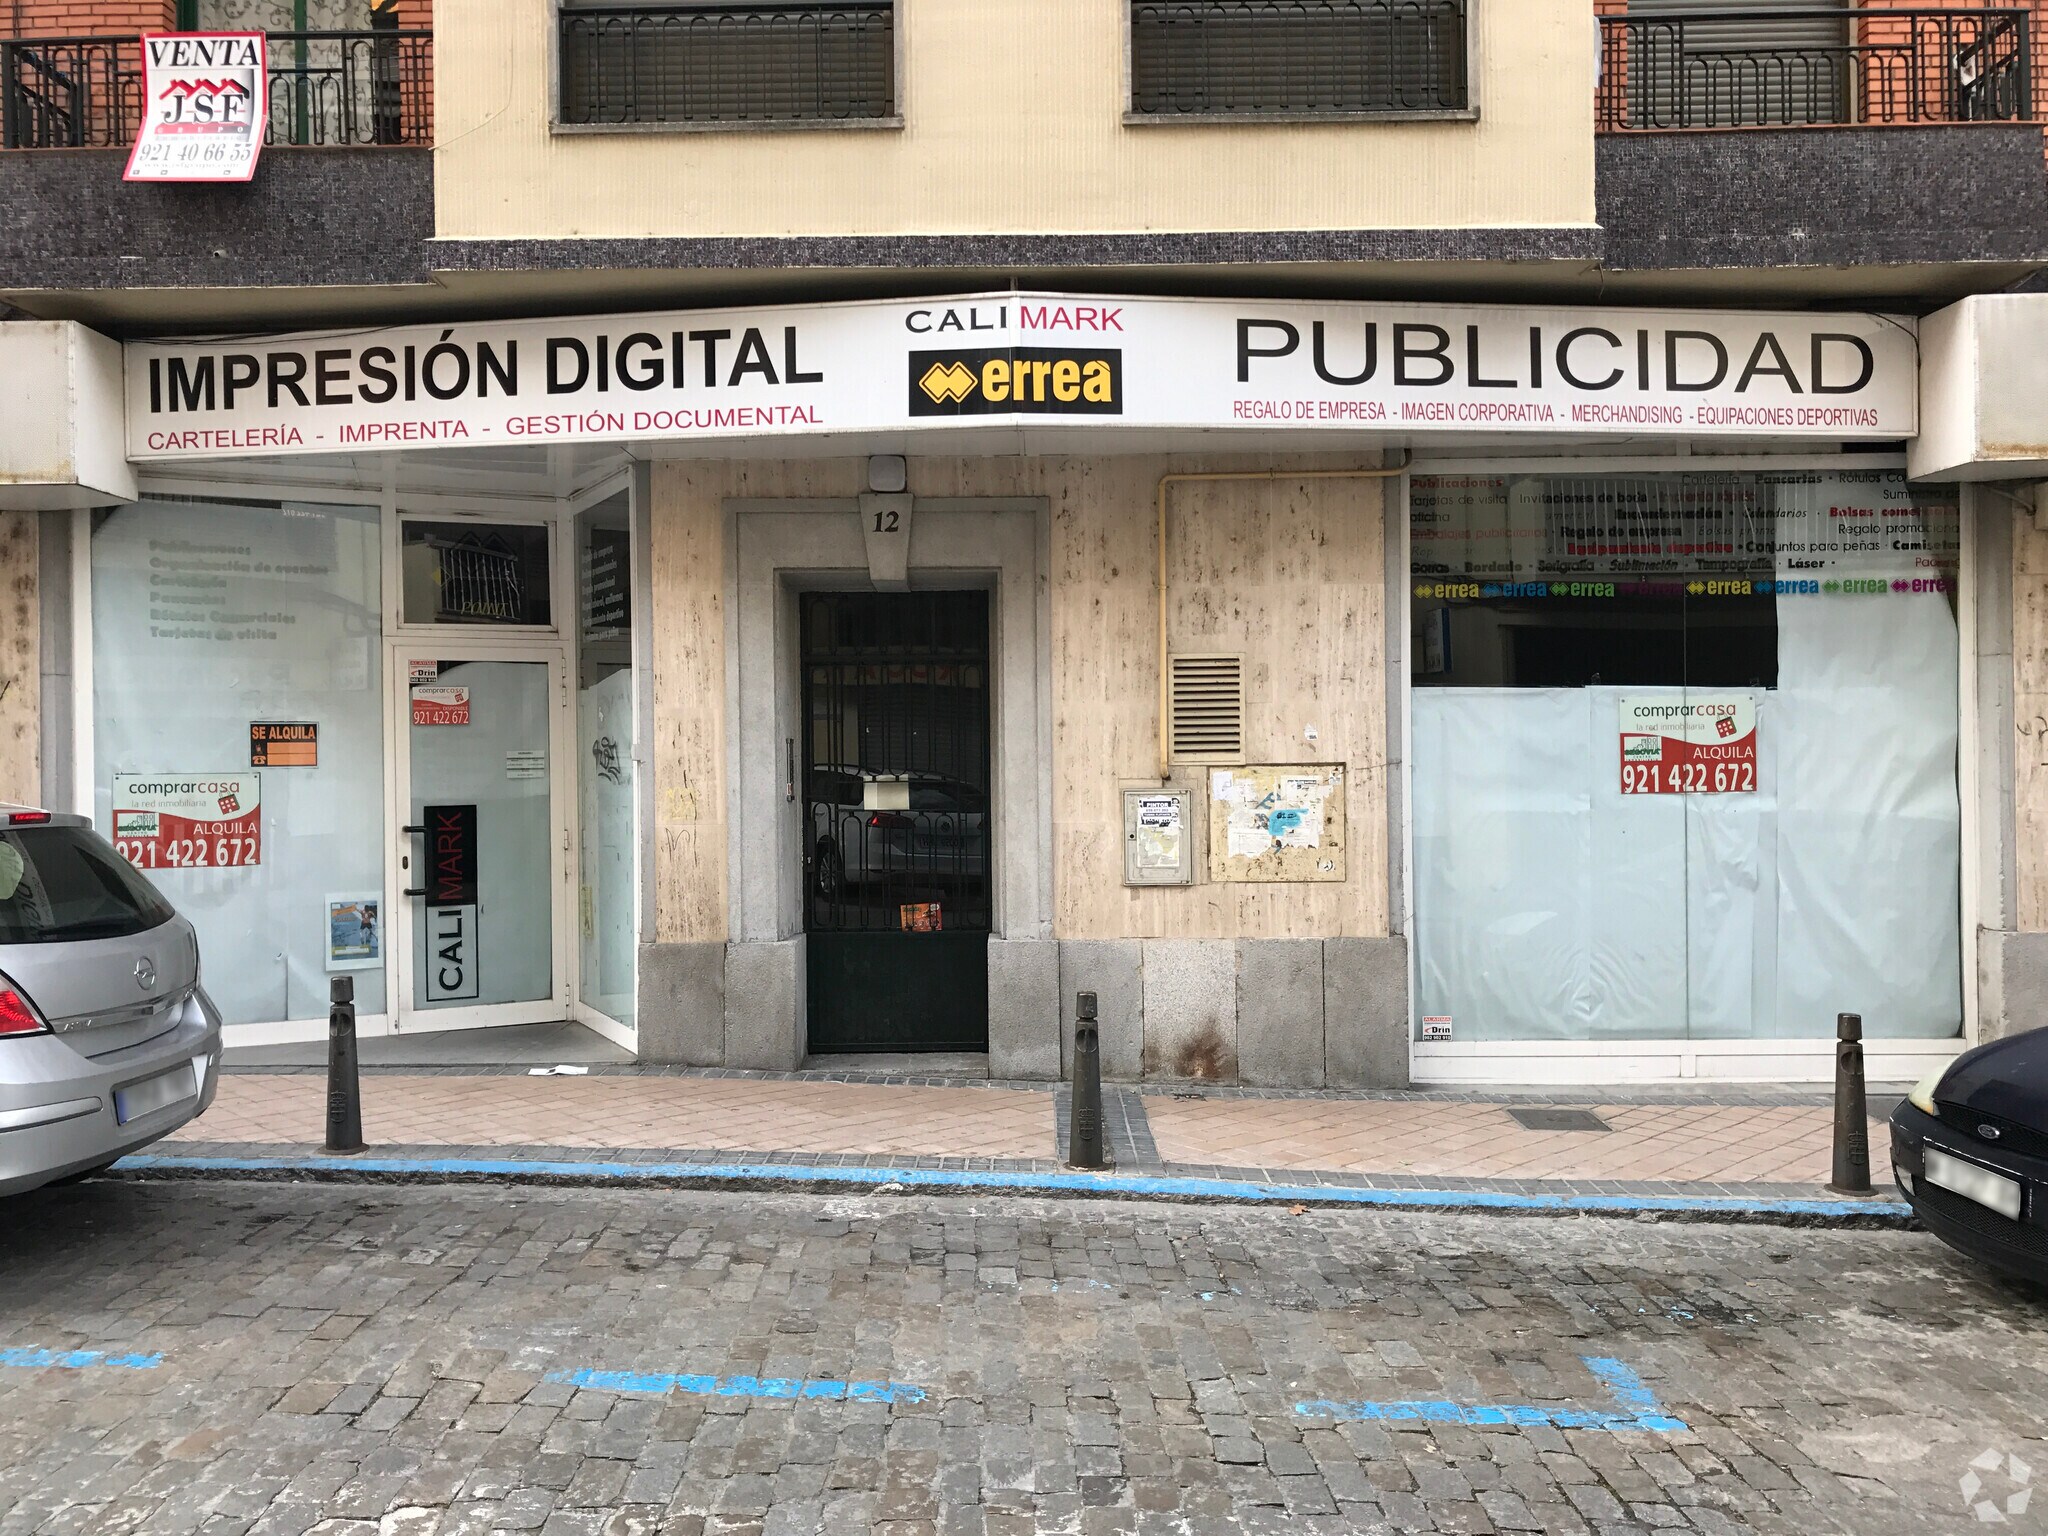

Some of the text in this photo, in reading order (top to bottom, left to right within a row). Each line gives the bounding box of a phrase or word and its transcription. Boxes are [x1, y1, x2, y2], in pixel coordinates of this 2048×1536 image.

[148, 39, 260, 67] VENTA
[163, 95, 244, 123] JSF
[139, 143, 171, 161] 921
[177, 143, 201, 161] 40
[203, 143, 227, 161] 66
[1237, 318, 1874, 395] PUBLICIDAD
[149, 326, 823, 413] IMPRESIÓN DIGITAL
[982, 360, 1112, 402] errea
[1233, 400, 1292, 419] REGALO
[1296, 401, 1315, 419] DE
[1319, 401, 1386, 420] EMPRESA
[1401, 402, 1455, 421] IMAGEN
[1458, 402, 1555, 422] CORPORATIVA
[1571, 404, 1683, 424] MERCHANDISING
[1697, 406, 1794, 426] EQUIPACIONES
[1797, 408, 1878, 426] DEPORTIVAS
[147, 423, 304, 450] CARTELERÍA
[339, 420, 469, 443] IMPRENTA
[506, 410, 624, 435] GESTIÓN
[634, 405, 823, 431] DOCUMENTAL
[1410, 477, 1504, 489] Publicaciones
[1410, 494, 1454, 507] Tarjetas
[1457, 493, 1475, 505] de
[1478, 493, 1508, 505] visita
[1519, 492, 1594, 505] Invitaciones
[1597, 492, 1614, 504] de
[1616, 490, 1648, 504] boda
[873, 511, 899, 533] 12
[1410, 512, 1450, 523] oficina
[1830, 506, 1874, 518] Bolsas
[1560, 526, 1604, 540] Regalo
[1838, 523, 1881, 537] Regalo
[1745, 541, 1806, 555] Conjuntos
[1809, 542, 1839, 554] para
[1843, 540, 1881, 553] peñas
[1788, 556, 1825, 569] Láser
[1434, 582, 1479, 598] errea
[1502, 581, 1547, 597] errea
[1570, 581, 1615, 597] errea
[1707, 580, 1751, 595] errea
[1775, 579, 1819, 594] errea
[1842, 578, 1888, 594] errea
[413, 711, 469, 725] 921 422 672
[1633, 704, 1737, 720] comprarcasa
[251, 725, 316, 741] SE ALQUILA
[1693, 745, 1754, 760] ALQUILA
[1623, 762, 1754, 794] 921 422 672
[128, 781, 240, 797] comprarcasa
[142, 799, 156, 808] red
[193, 822, 258, 836] ALQUILA
[165, 839, 208, 868] 422
[215, 837, 257, 866] 672
